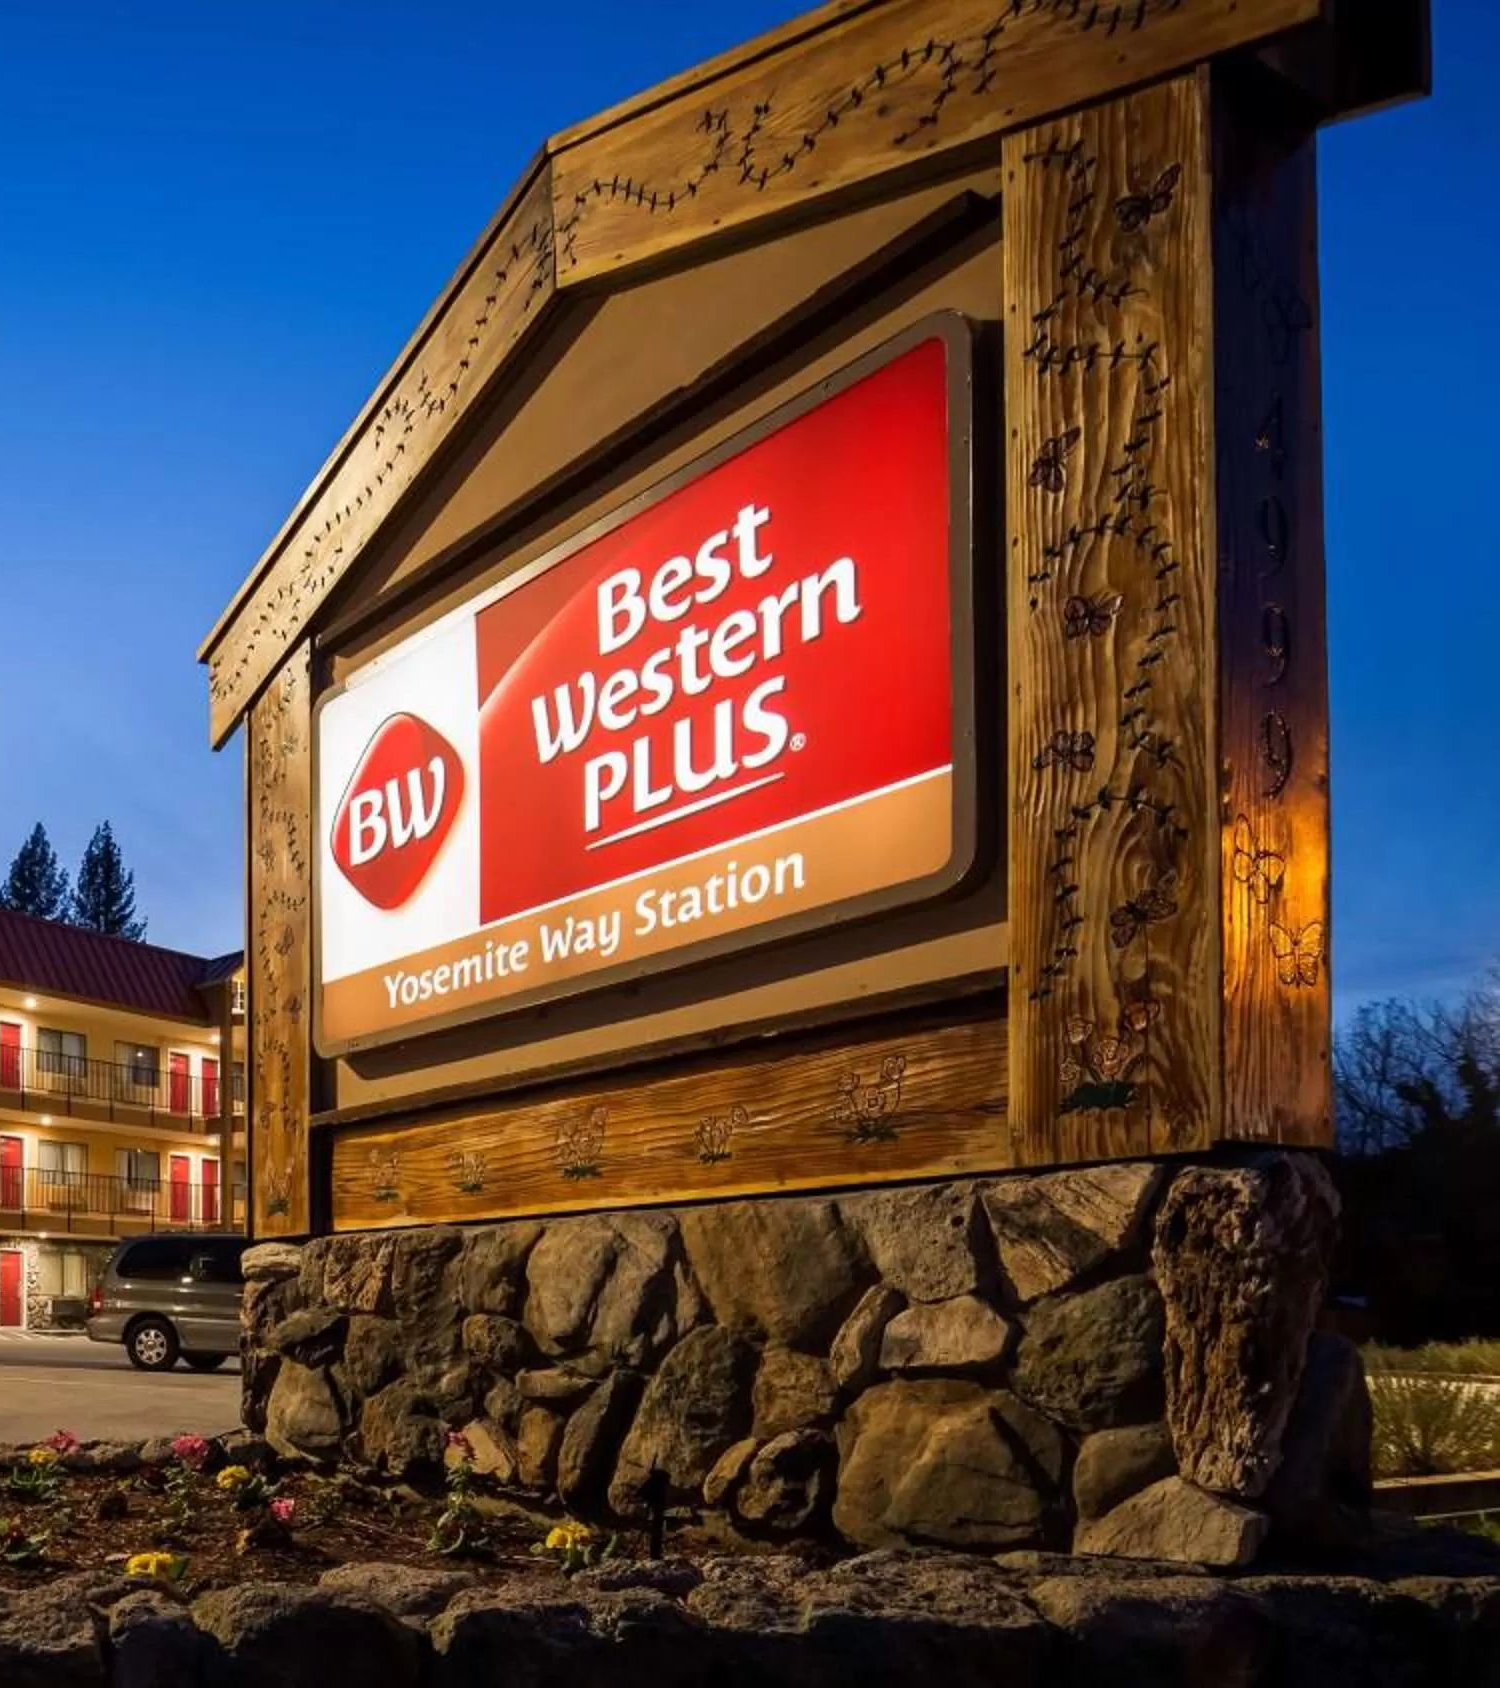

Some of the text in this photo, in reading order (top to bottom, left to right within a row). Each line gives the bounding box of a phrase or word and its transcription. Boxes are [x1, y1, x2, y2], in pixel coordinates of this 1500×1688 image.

[596, 502, 775, 656] Best
[531, 556, 863, 765] Western
[347, 755, 446, 868] BW
[383, 851, 806, 1009] Yosemite Way Station
